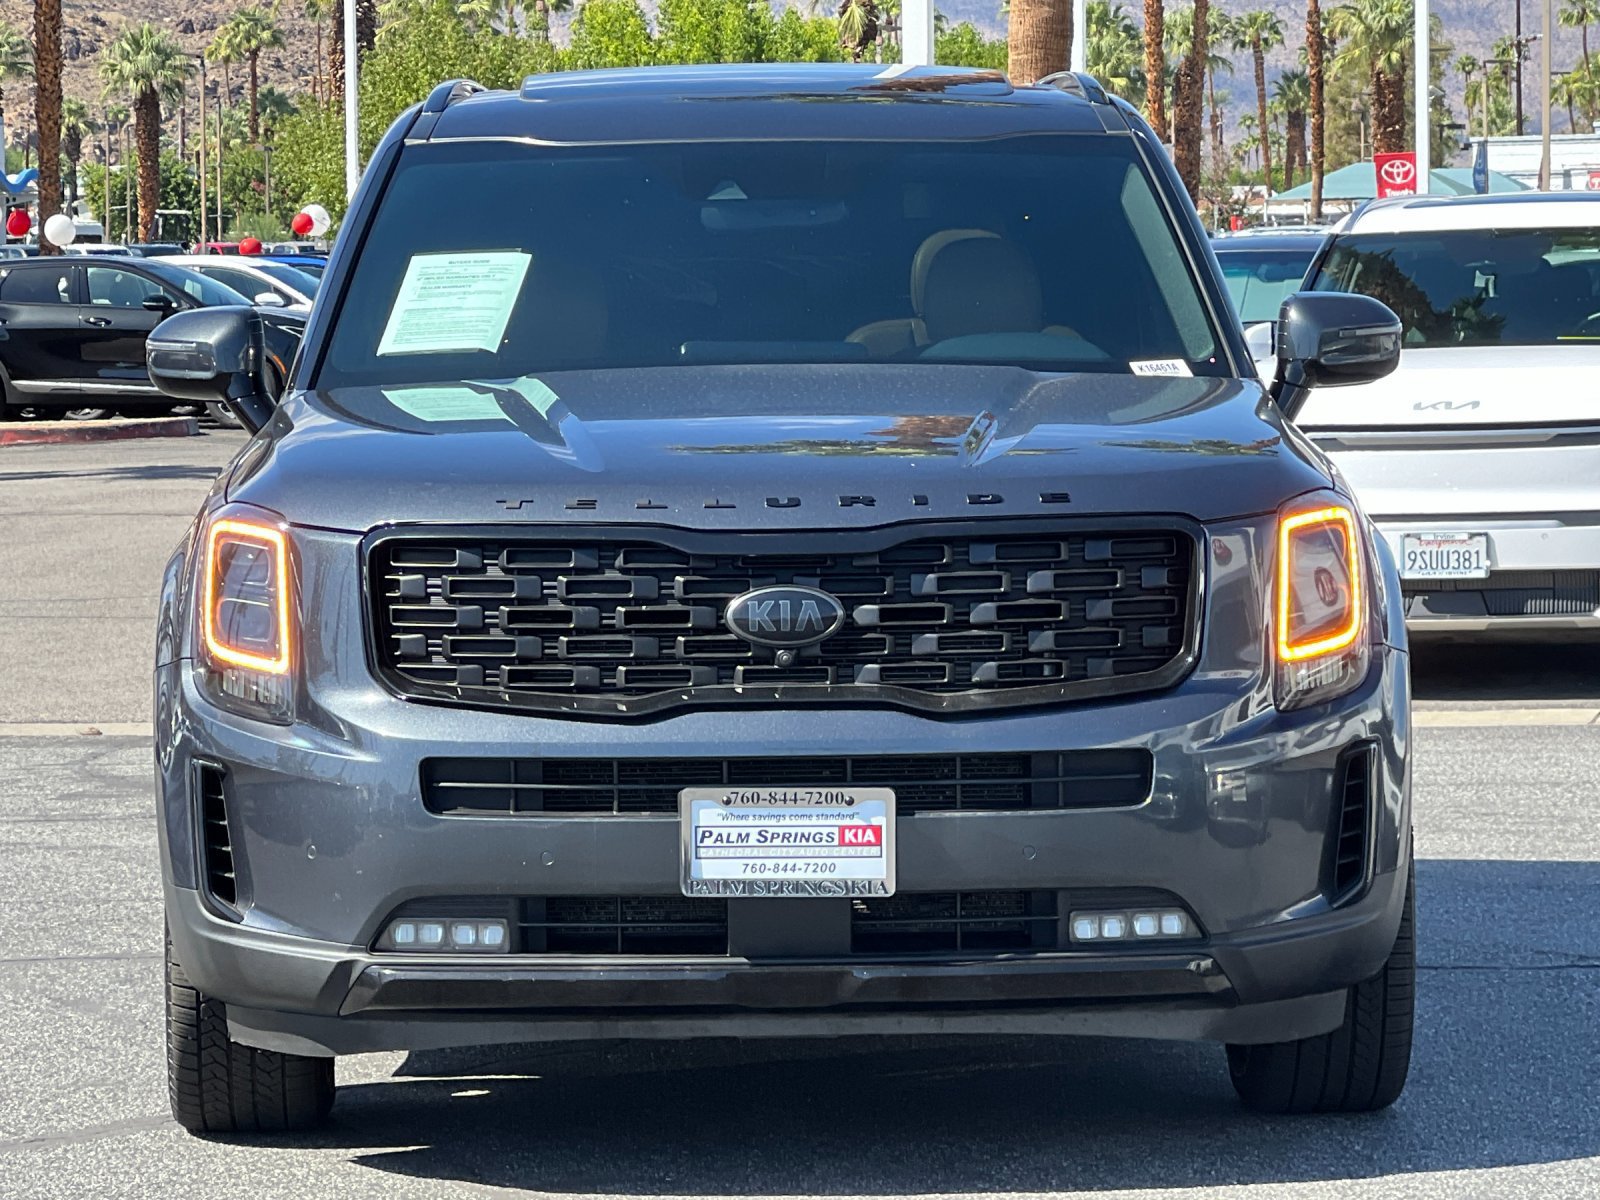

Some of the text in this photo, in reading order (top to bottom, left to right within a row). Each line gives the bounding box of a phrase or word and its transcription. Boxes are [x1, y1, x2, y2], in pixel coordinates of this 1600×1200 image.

[496, 493, 1071, 510] TELLURIDE
[1407, 549, 1483, 571] 9SUU381
[747, 599, 825, 632] KIA
[730, 791, 845, 805] 760-844-7200
[752, 812, 786, 823] savings
[699, 828, 876, 844] PALM SPRINGS KIA
[770, 848, 794, 856] CITY
[798, 847, 828, 856] AUTO
[742, 862, 836, 874] 760-844-7200
[688, 880, 889, 895] PALM SPRINGS KIA
